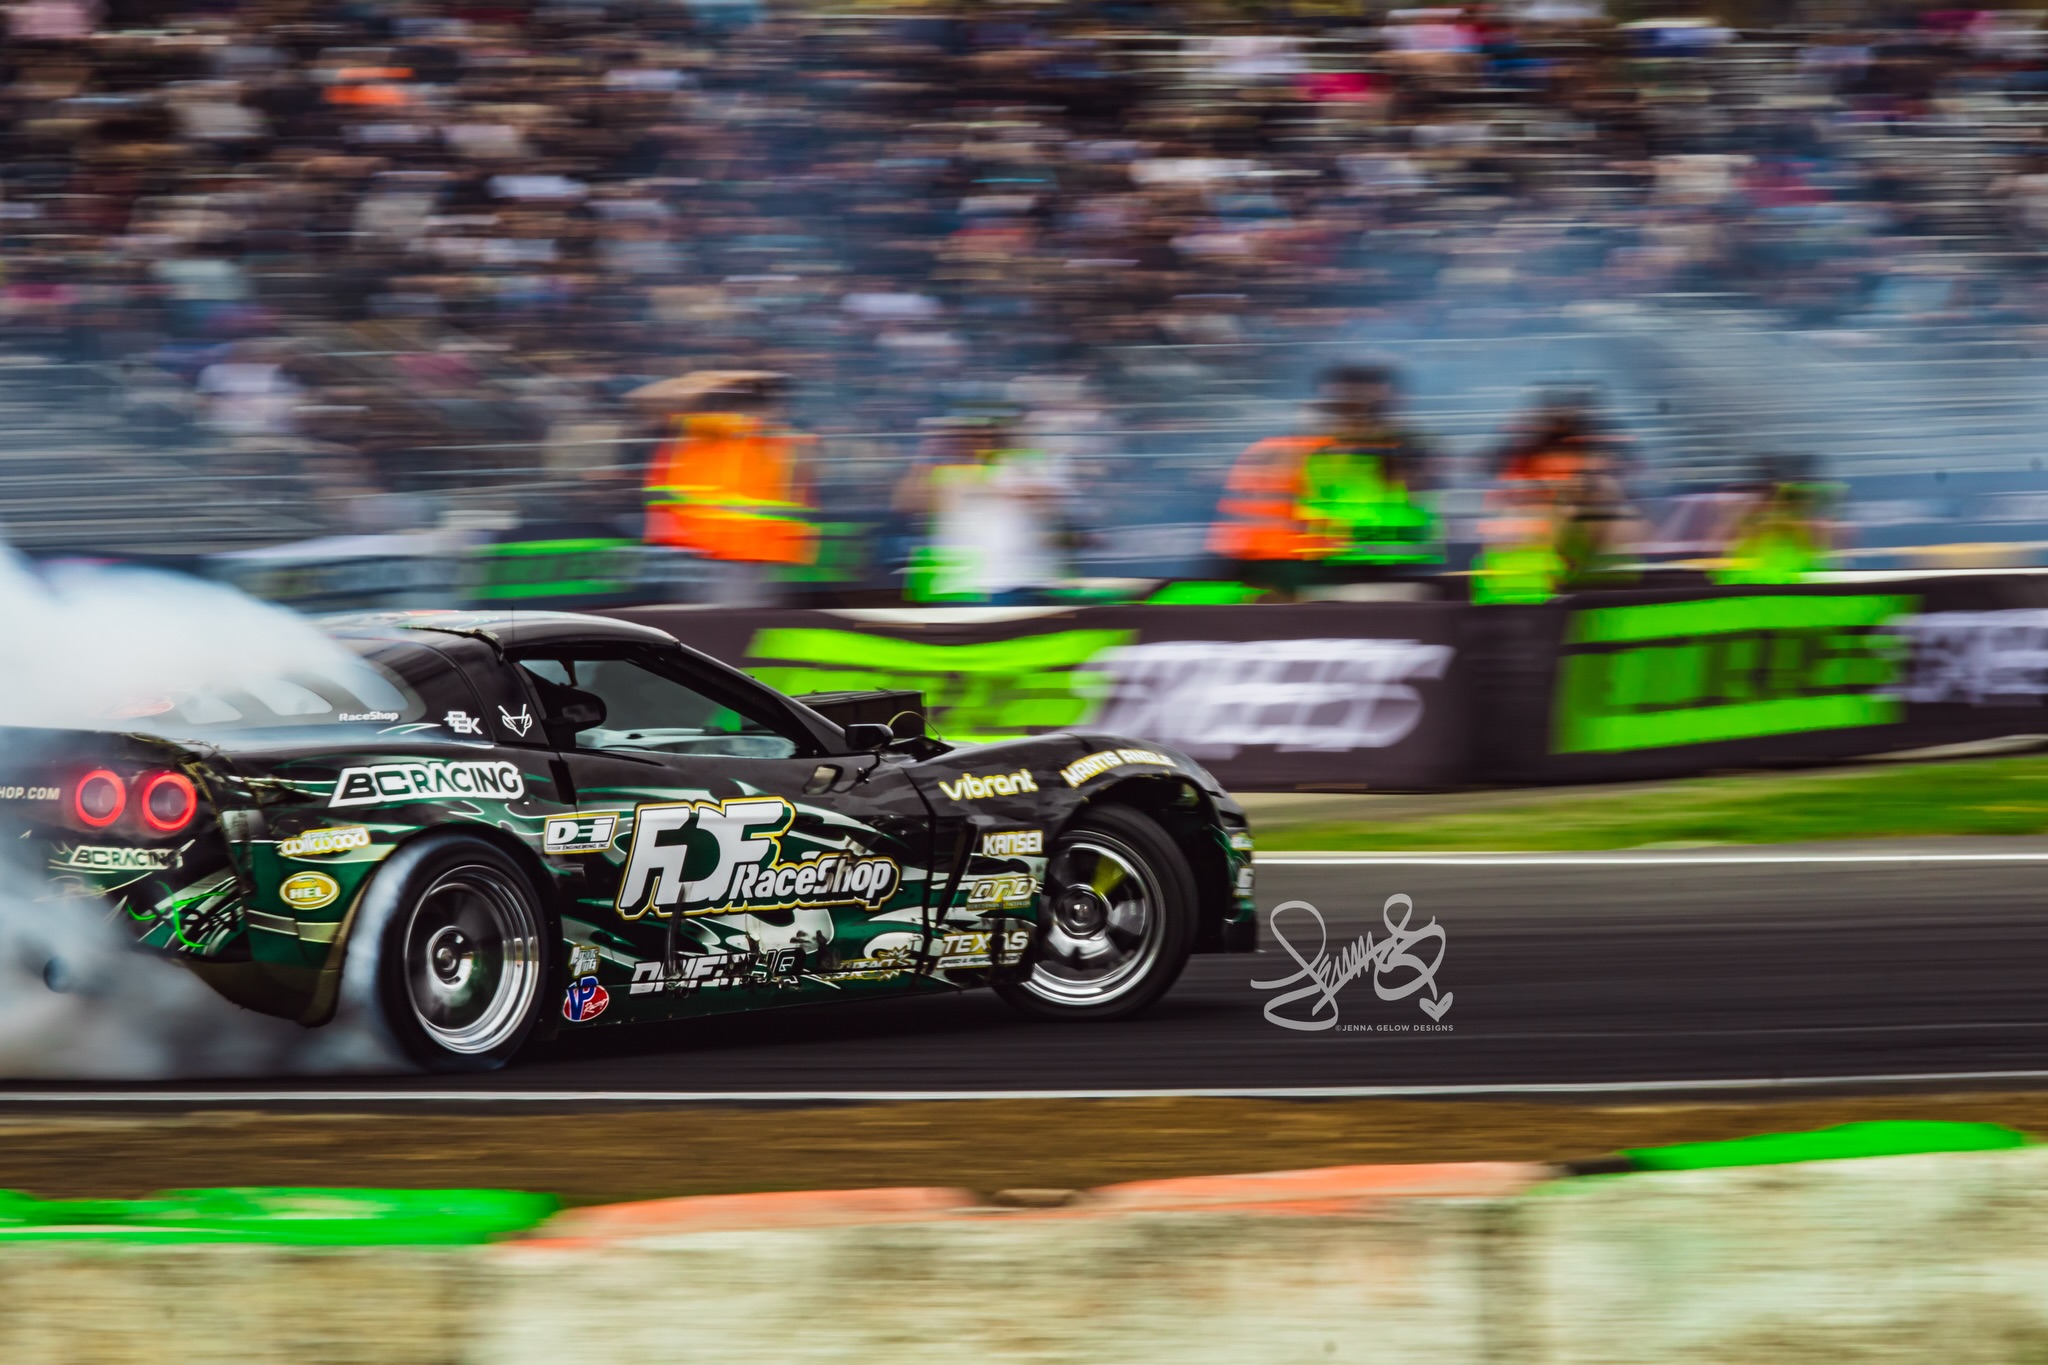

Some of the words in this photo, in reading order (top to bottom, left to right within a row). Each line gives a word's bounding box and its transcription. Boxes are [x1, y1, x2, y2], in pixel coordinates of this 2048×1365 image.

[338, 711, 399, 722] RaceShop
[1060, 749, 1123, 787] MANTIS
[280, 828, 370, 856] wilwood
[983, 831, 1043, 855] KANSEI
[727, 854, 892, 901] RaceShop
[289, 886, 328, 900] HEL
[566, 976, 599, 1021] VP
